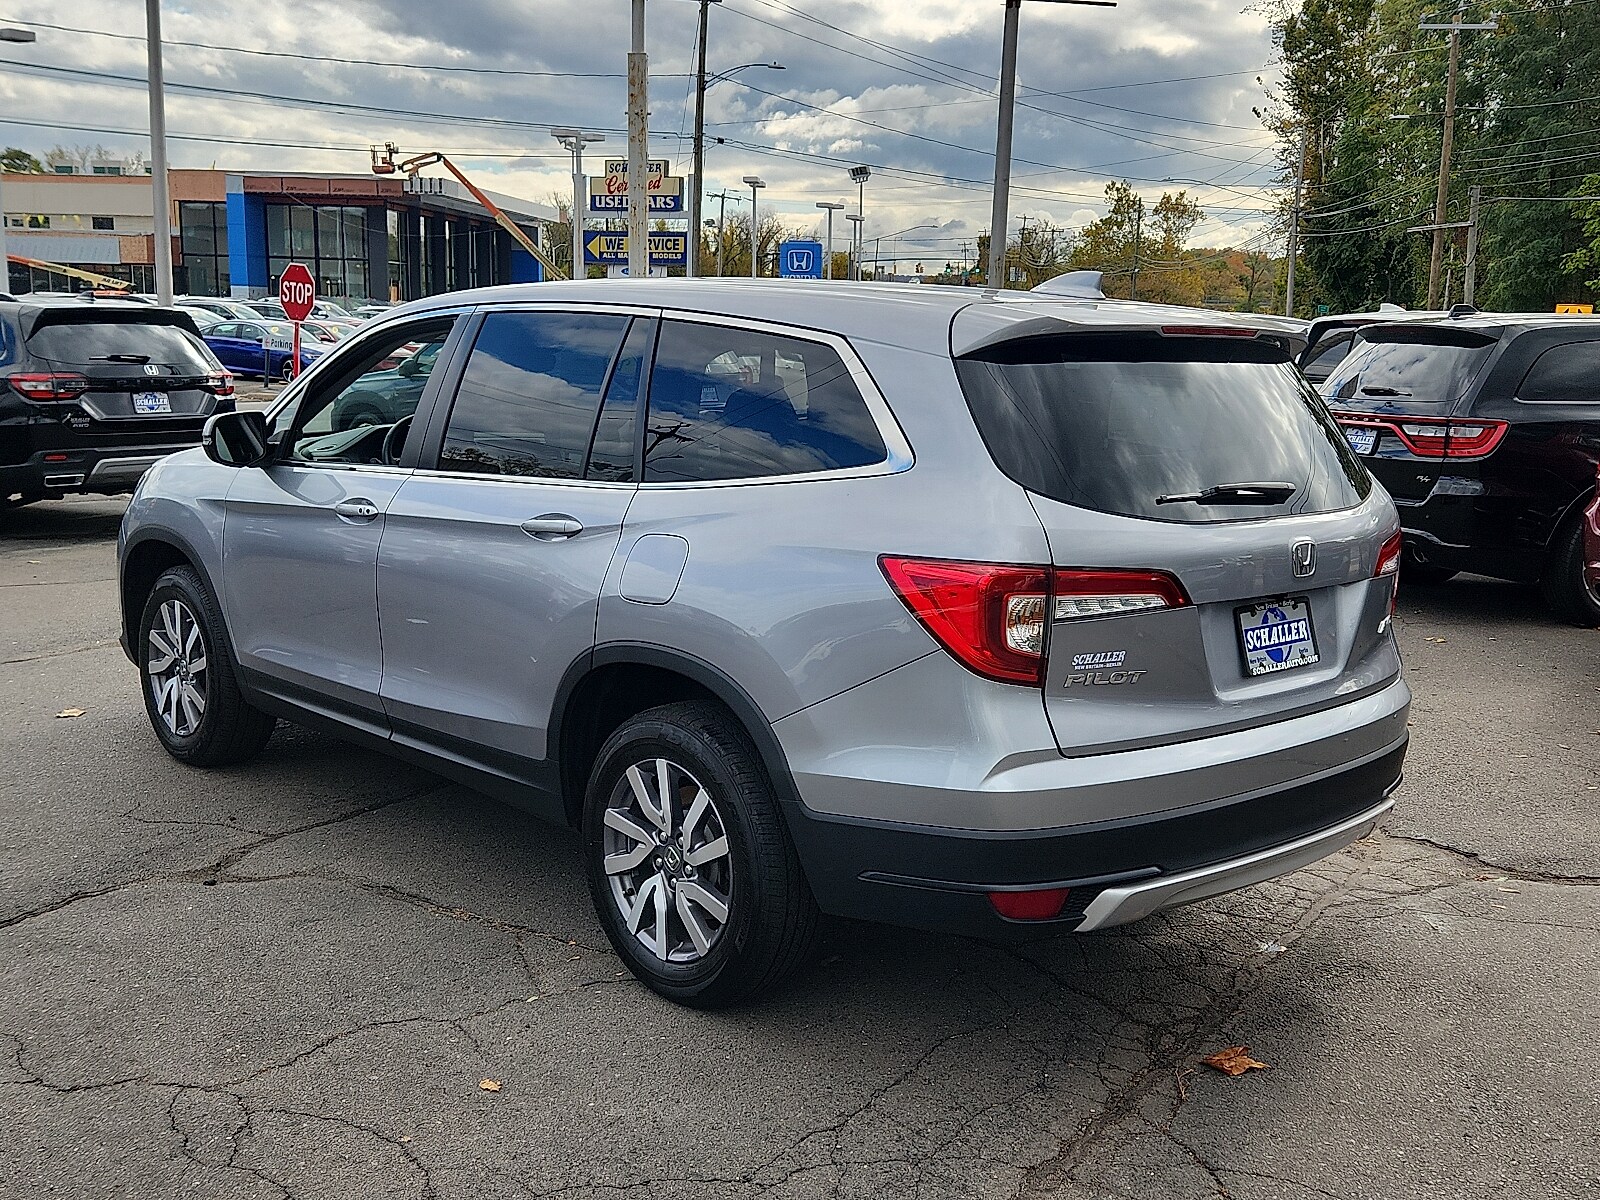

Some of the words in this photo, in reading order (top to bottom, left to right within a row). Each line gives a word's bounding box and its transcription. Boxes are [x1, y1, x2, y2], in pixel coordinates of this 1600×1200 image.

[608, 163, 662, 173] SCHER
[605, 174, 663, 194] Cered
[648, 196, 675, 209] ARS
[604, 238, 625, 251] WE
[648, 238, 680, 251] RVICE
[281, 280, 313, 305] STOP
[270, 338, 293, 352] Parking
[136, 398, 168, 406] SCHALLER
[1246, 620, 1308, 650] SCHALLER
[1071, 650, 1126, 666] SCHALLER
[1252, 654, 1319, 676] SCHALLERAUTO.COM
[1063, 670, 1147, 688] PILOT
